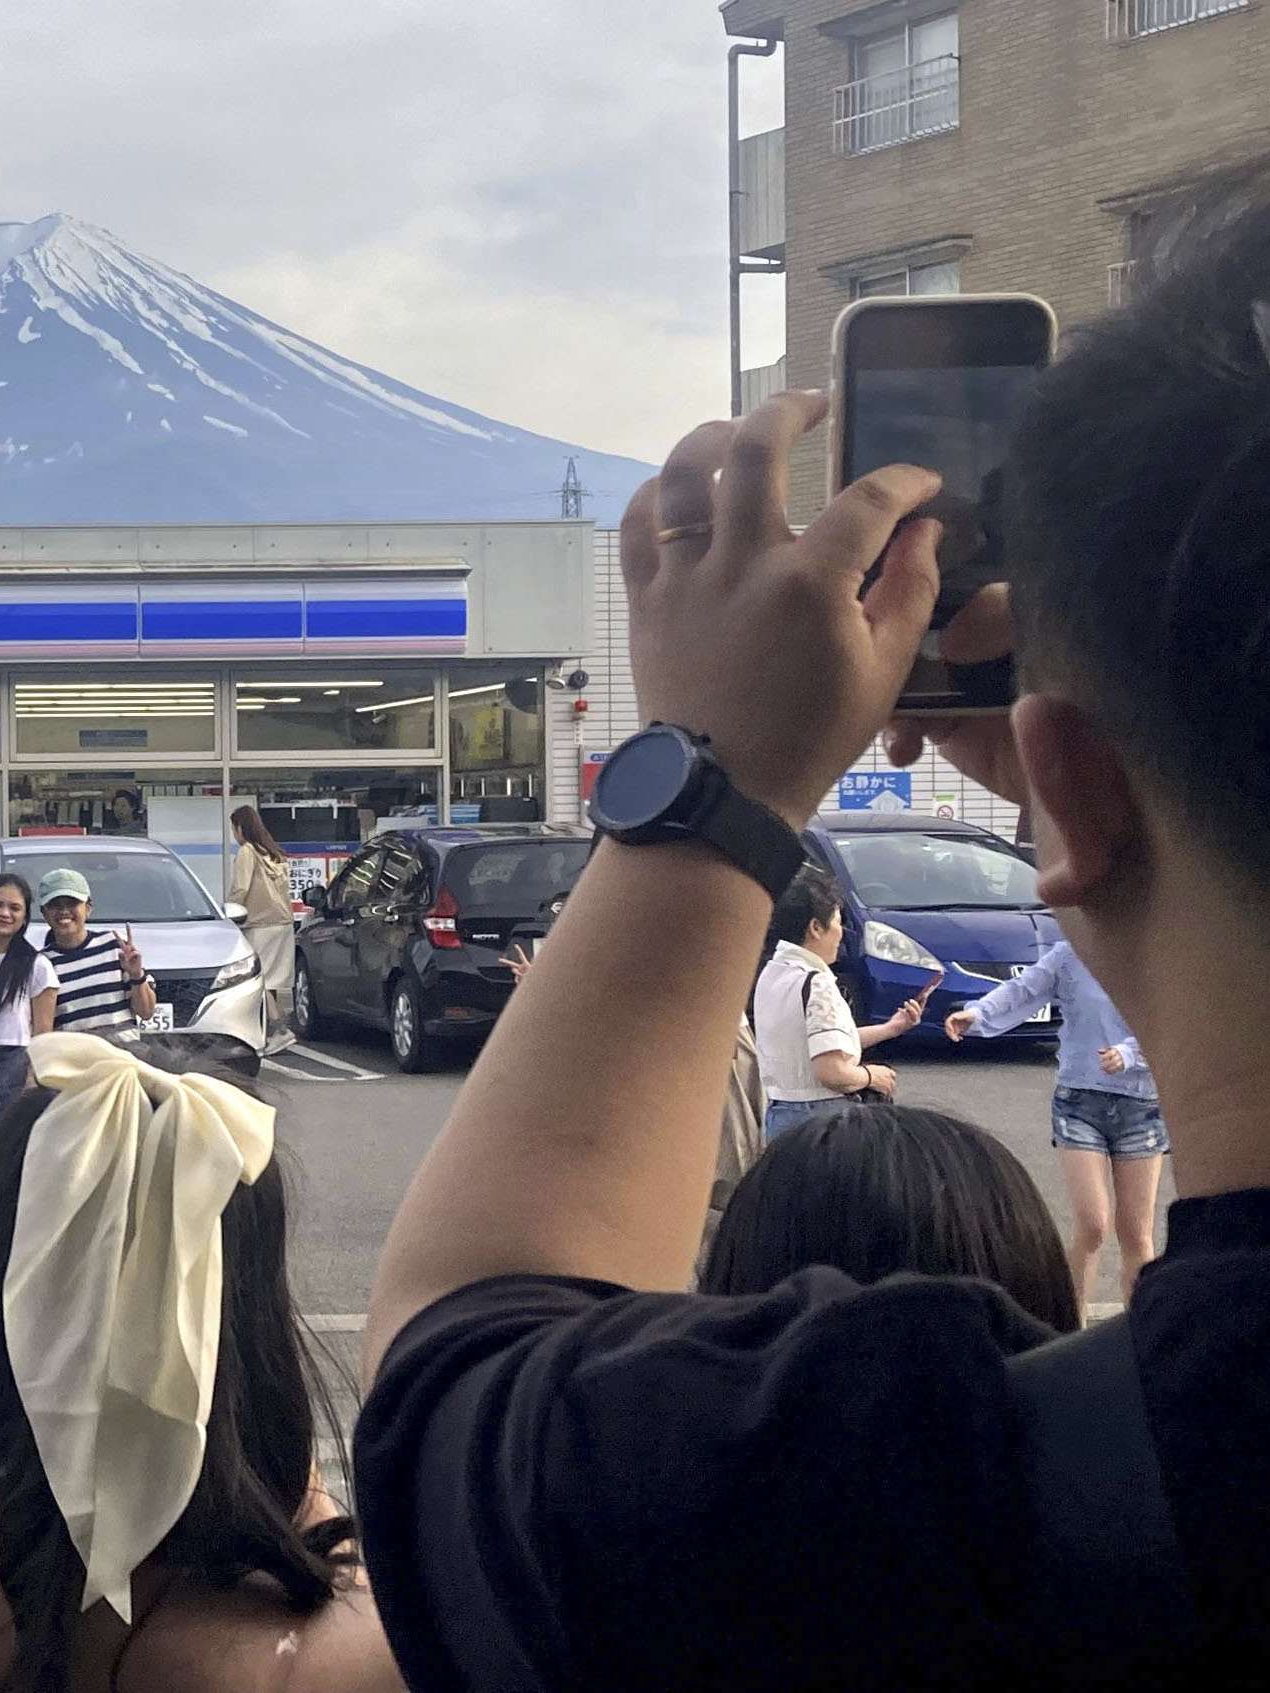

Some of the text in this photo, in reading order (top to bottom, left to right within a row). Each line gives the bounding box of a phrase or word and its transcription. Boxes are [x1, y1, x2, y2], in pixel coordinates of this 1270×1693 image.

[841, 775, 897, 789] お静かに
[289, 867, 322, 878] おにぎり
